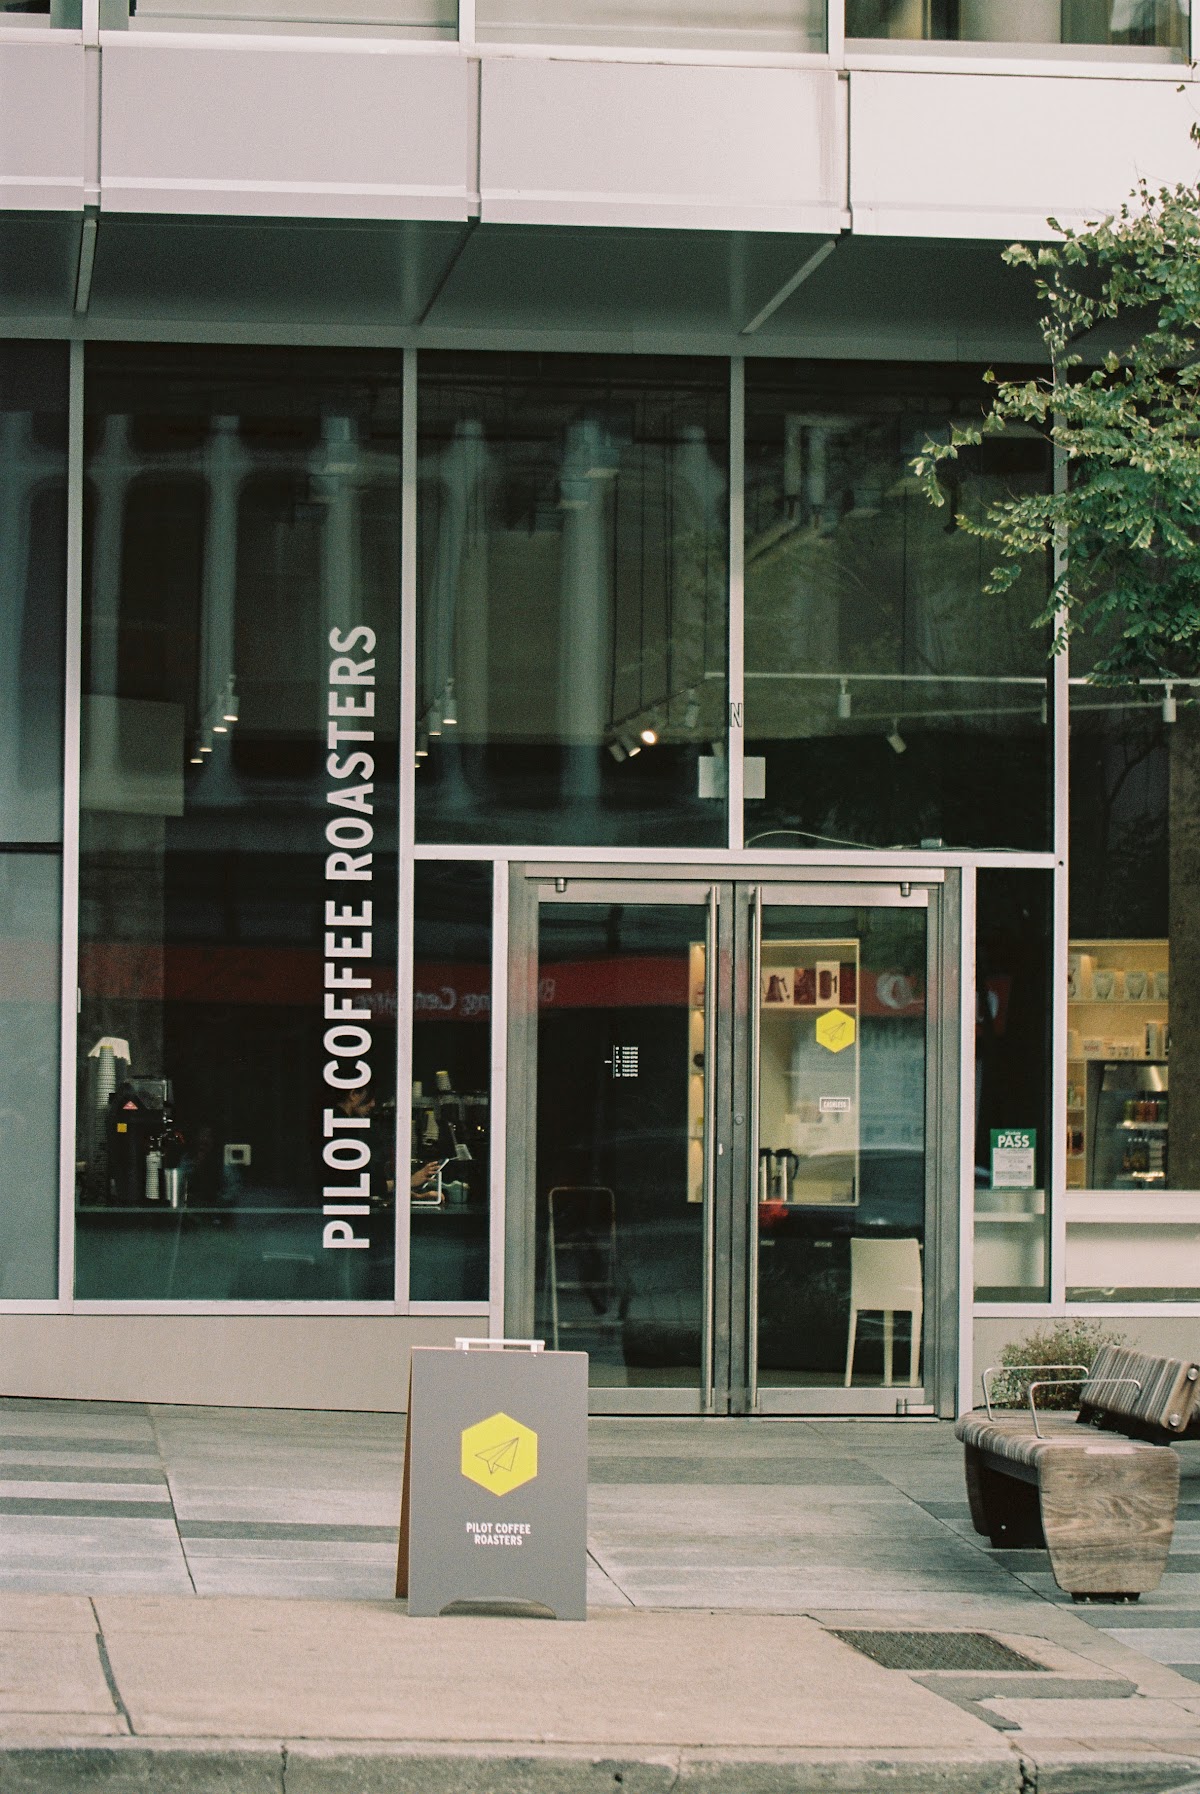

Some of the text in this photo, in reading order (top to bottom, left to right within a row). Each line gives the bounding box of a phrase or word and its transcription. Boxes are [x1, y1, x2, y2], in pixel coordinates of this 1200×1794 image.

[323, 625, 377, 1249] PILOT COFFEE ROASTERS
[997, 1135, 1030, 1147] PASS
[466, 1522, 531, 1534] PILOT COFFEE
[474, 1534, 523, 1545] ROASTERS
